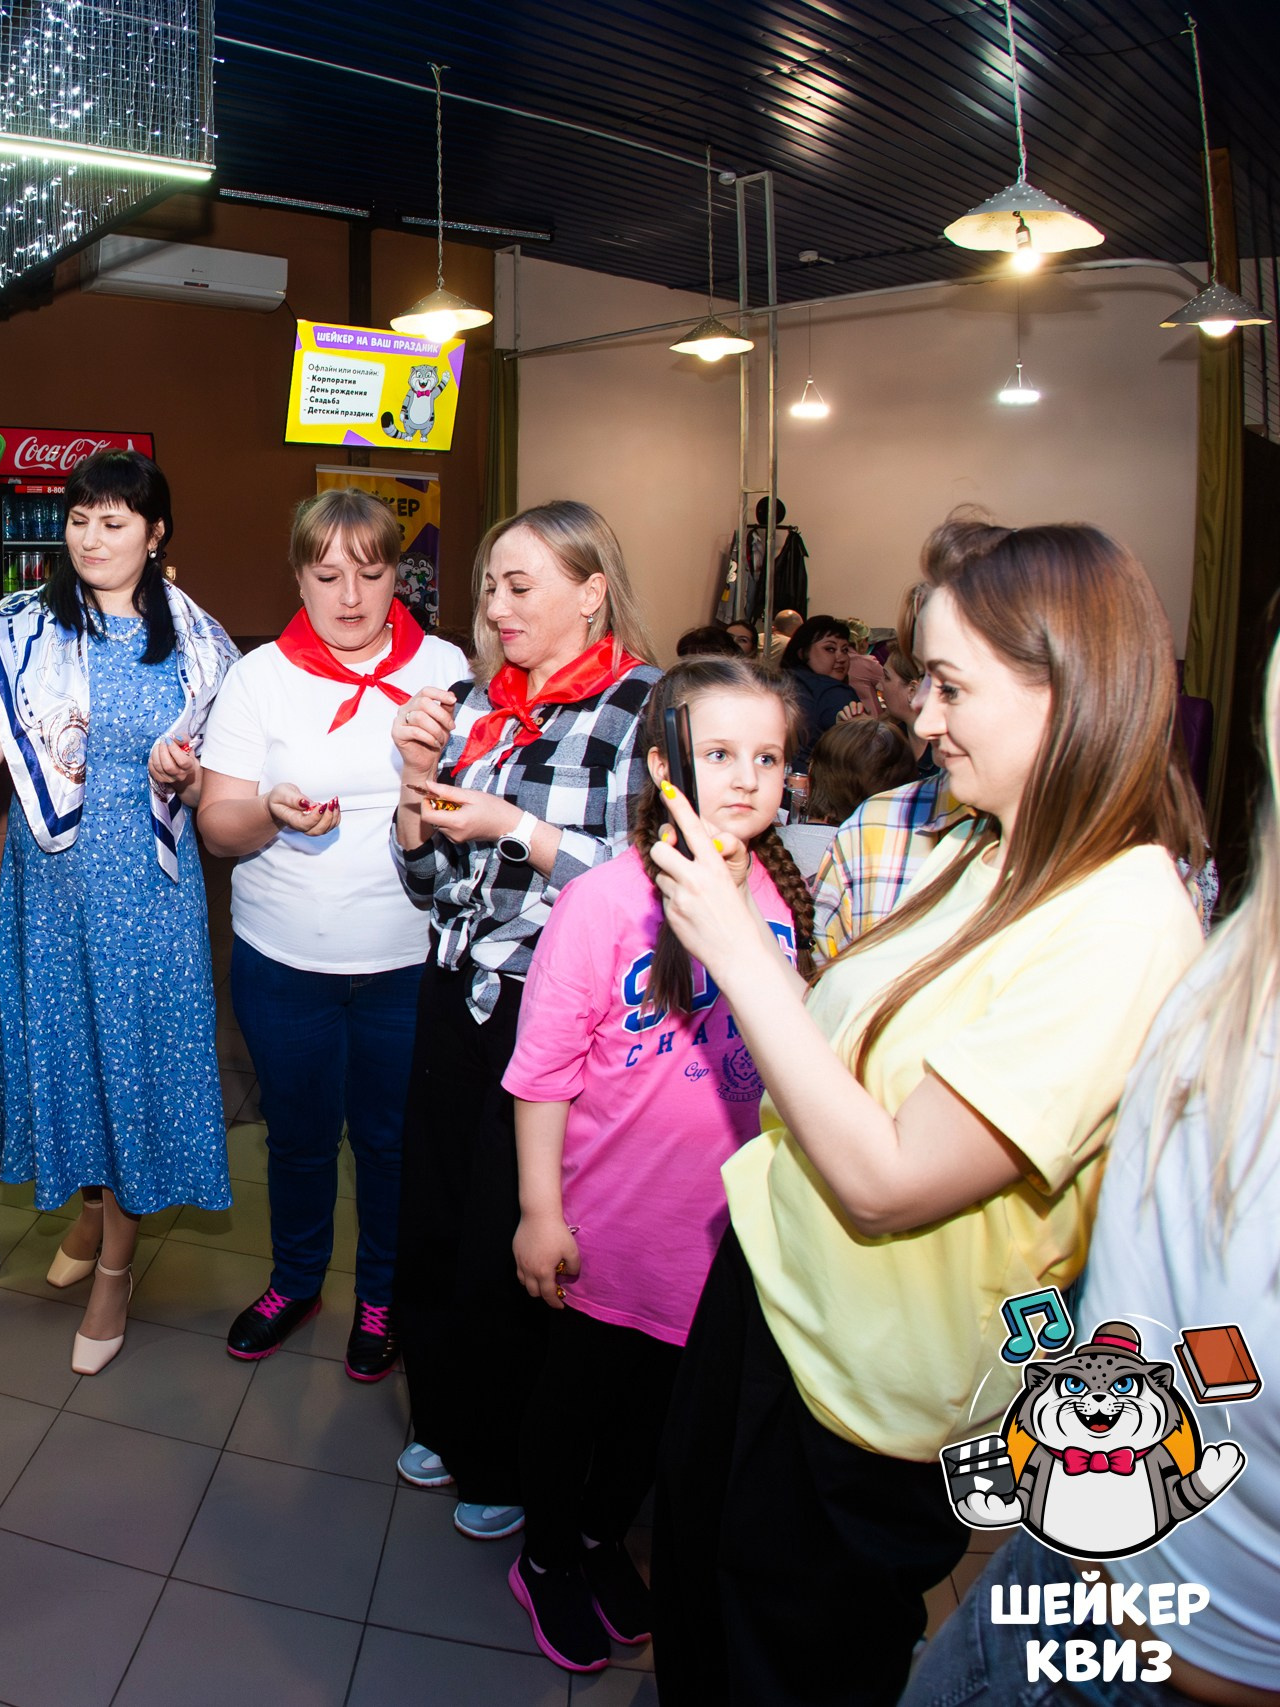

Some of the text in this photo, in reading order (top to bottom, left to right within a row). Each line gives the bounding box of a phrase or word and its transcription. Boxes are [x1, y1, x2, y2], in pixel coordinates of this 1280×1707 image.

[317, 331, 439, 353] ШЕЙКЕР НА ВАШ ПРАЗДНИК
[308, 363, 337, 372] Офлайн
[311, 374, 356, 384] Корпоратив
[310, 385, 368, 396] День рождения
[309, 396, 340, 404] Свадьба
[307, 406, 340, 415] Детский
[684, 1062, 710, 1082] Cup
